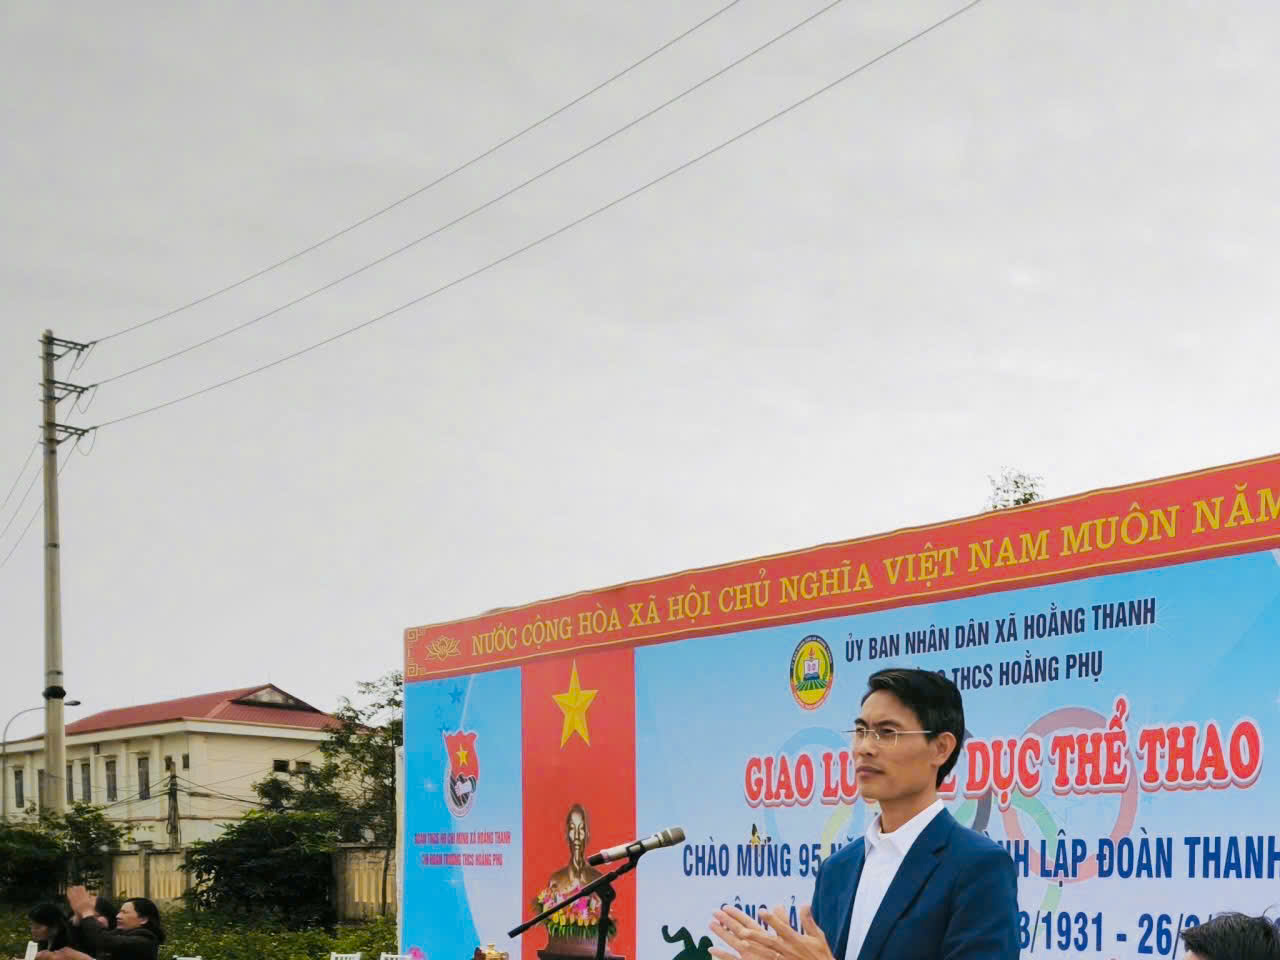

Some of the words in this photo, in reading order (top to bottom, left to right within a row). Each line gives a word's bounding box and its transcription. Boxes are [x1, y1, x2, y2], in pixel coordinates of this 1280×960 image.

[472, 624, 517, 655] NƯỚC
[521, 615, 573, 649] CỘNG
[578, 603, 622, 636] HÒA
[628, 596, 661, 628] XÃ
[667, 584, 711, 624] HỘI
[719, 568, 770, 613] CHỦ
[779, 560, 874, 604] NGHĨA
[883, 542, 959, 587] VIỆT
[968, 530, 1050, 571] NAM
[1059, 502, 1180, 557] MUÔN
[845, 632, 864, 663] ỦY
[869, 635, 900, 659] BAN
[905, 624, 950, 655] NHÂN
[955, 618, 989, 649] DÂN
[995, 612, 1018, 644] XÃ
[1023, 602, 1085, 641] HOẰNG
[1091, 598, 1156, 631] THANH
[951, 663, 993, 691] THCS
[999, 650, 1059, 686] HOẰNG
[1065, 650, 1103, 682] PHỤ
[745, 752, 815, 803] GIAO
[965, 736, 1042, 804] DỤC
[1051, 697, 1128, 789] THỂ
[1138, 720, 1261, 786] THAO
[683, 836, 730, 877] CHÀO
[799, 843, 822, 877] 95
[1040, 829, 1087, 887] LẬP
[1096, 828, 1173, 879] ĐOÀN
[1019, 910, 1103, 953] 3/1931
[1116, 933, 1127, 942] -
